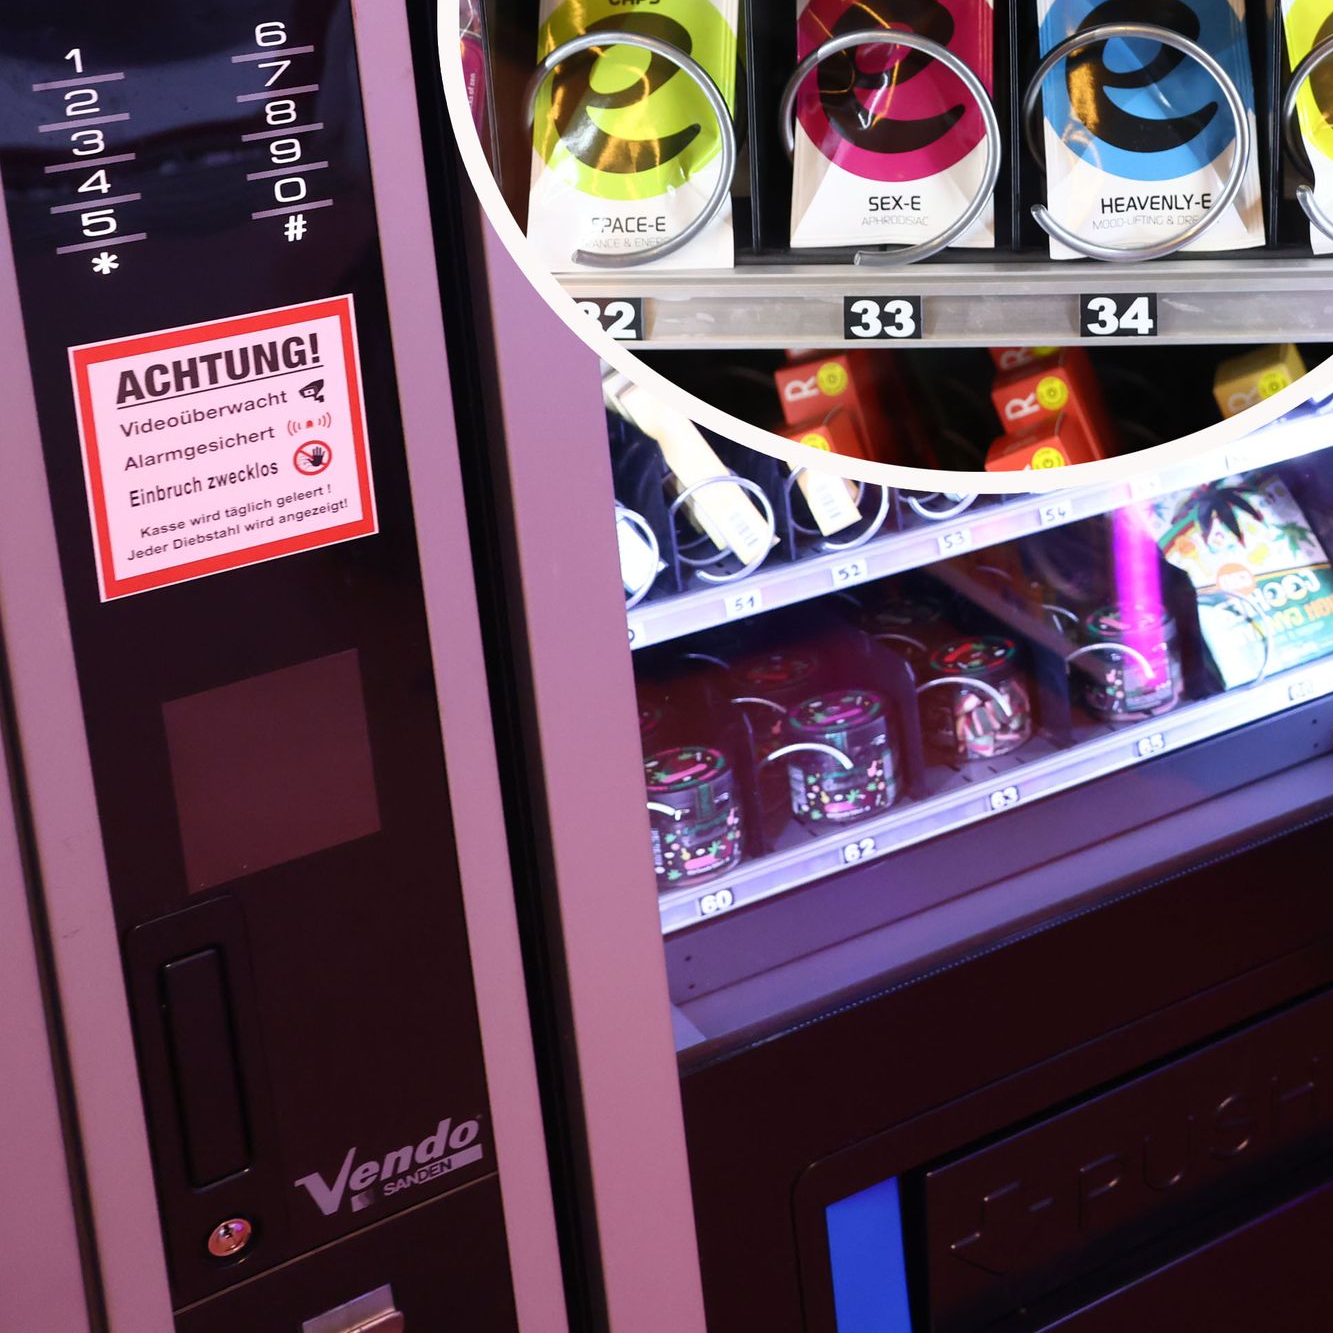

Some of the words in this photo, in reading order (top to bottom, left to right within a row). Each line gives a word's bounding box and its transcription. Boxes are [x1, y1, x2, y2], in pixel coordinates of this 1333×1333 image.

[255, 21, 288, 48] 6
[64, 48, 84, 74] 1
[257, 60, 293, 88] 7
[65, 88, 99, 116] 2
[265, 99, 298, 126] 8
[71, 130, 105, 156] 3
[270, 138, 302, 164] 9
[77, 169, 111, 195] 4
[274, 177, 308, 203] 0
[868, 195, 922, 212] SEX-E
[1101, 193, 1212, 214] HEAVENLY-E
[81, 210, 117, 237] 5
[850, 299, 916, 339] 33
[1086, 297, 1154, 335] 34
[116, 333, 322, 405] ACHTUNG!
[120, 390, 288, 439] Videoüberwacht
[124, 426, 276, 472] Alarmgesichert
[129, 473, 202, 508] Einbruch
[207, 460, 279, 495] zwecklos
[140, 517, 187, 539] Kasse
[190, 508, 220, 529] wird
[224, 497, 273, 523] täglich
[277, 489, 325, 514] geleert
[1046, 506, 1067, 520] 54
[127, 540, 168, 562] Jeder
[173, 523, 240, 552] Diebstahl
[245, 516, 275, 536] wird
[278, 498, 348, 529] angezeigt!
[944, 532, 966, 548] 53
[837, 564, 861, 581] 52
[734, 596, 755, 611] 51
[1138, 735, 1166, 756] 65
[990, 787, 1020, 810] 63
[843, 838, 876, 862] 62
[700, 889, 733, 914] 60
[295, 1117, 480, 1216] Vendo
[383, 1158, 451, 1197] SANDEN
